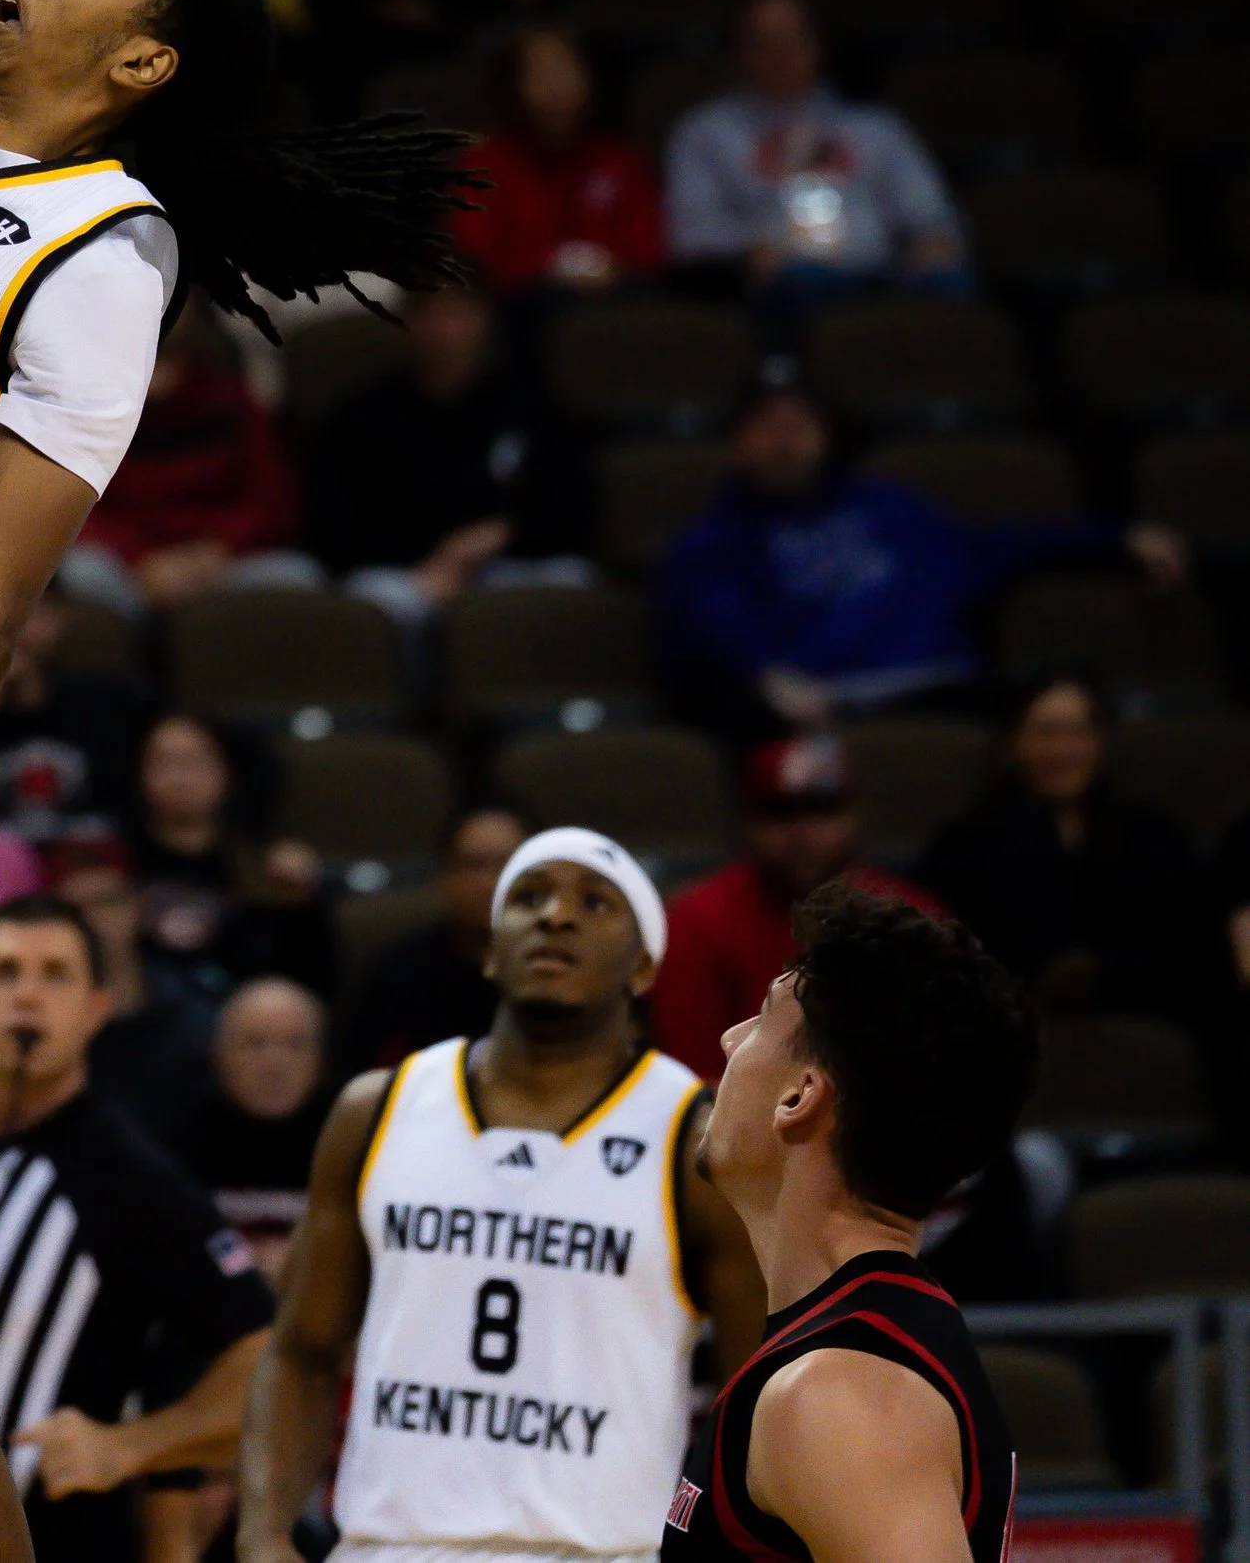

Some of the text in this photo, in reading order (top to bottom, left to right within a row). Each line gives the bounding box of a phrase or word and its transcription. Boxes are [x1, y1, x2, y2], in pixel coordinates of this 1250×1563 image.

[384, 1204, 634, 1277] NORTHERN
[471, 1278, 522, 1375] 8
[375, 1381, 608, 1457] KENTUCKY
